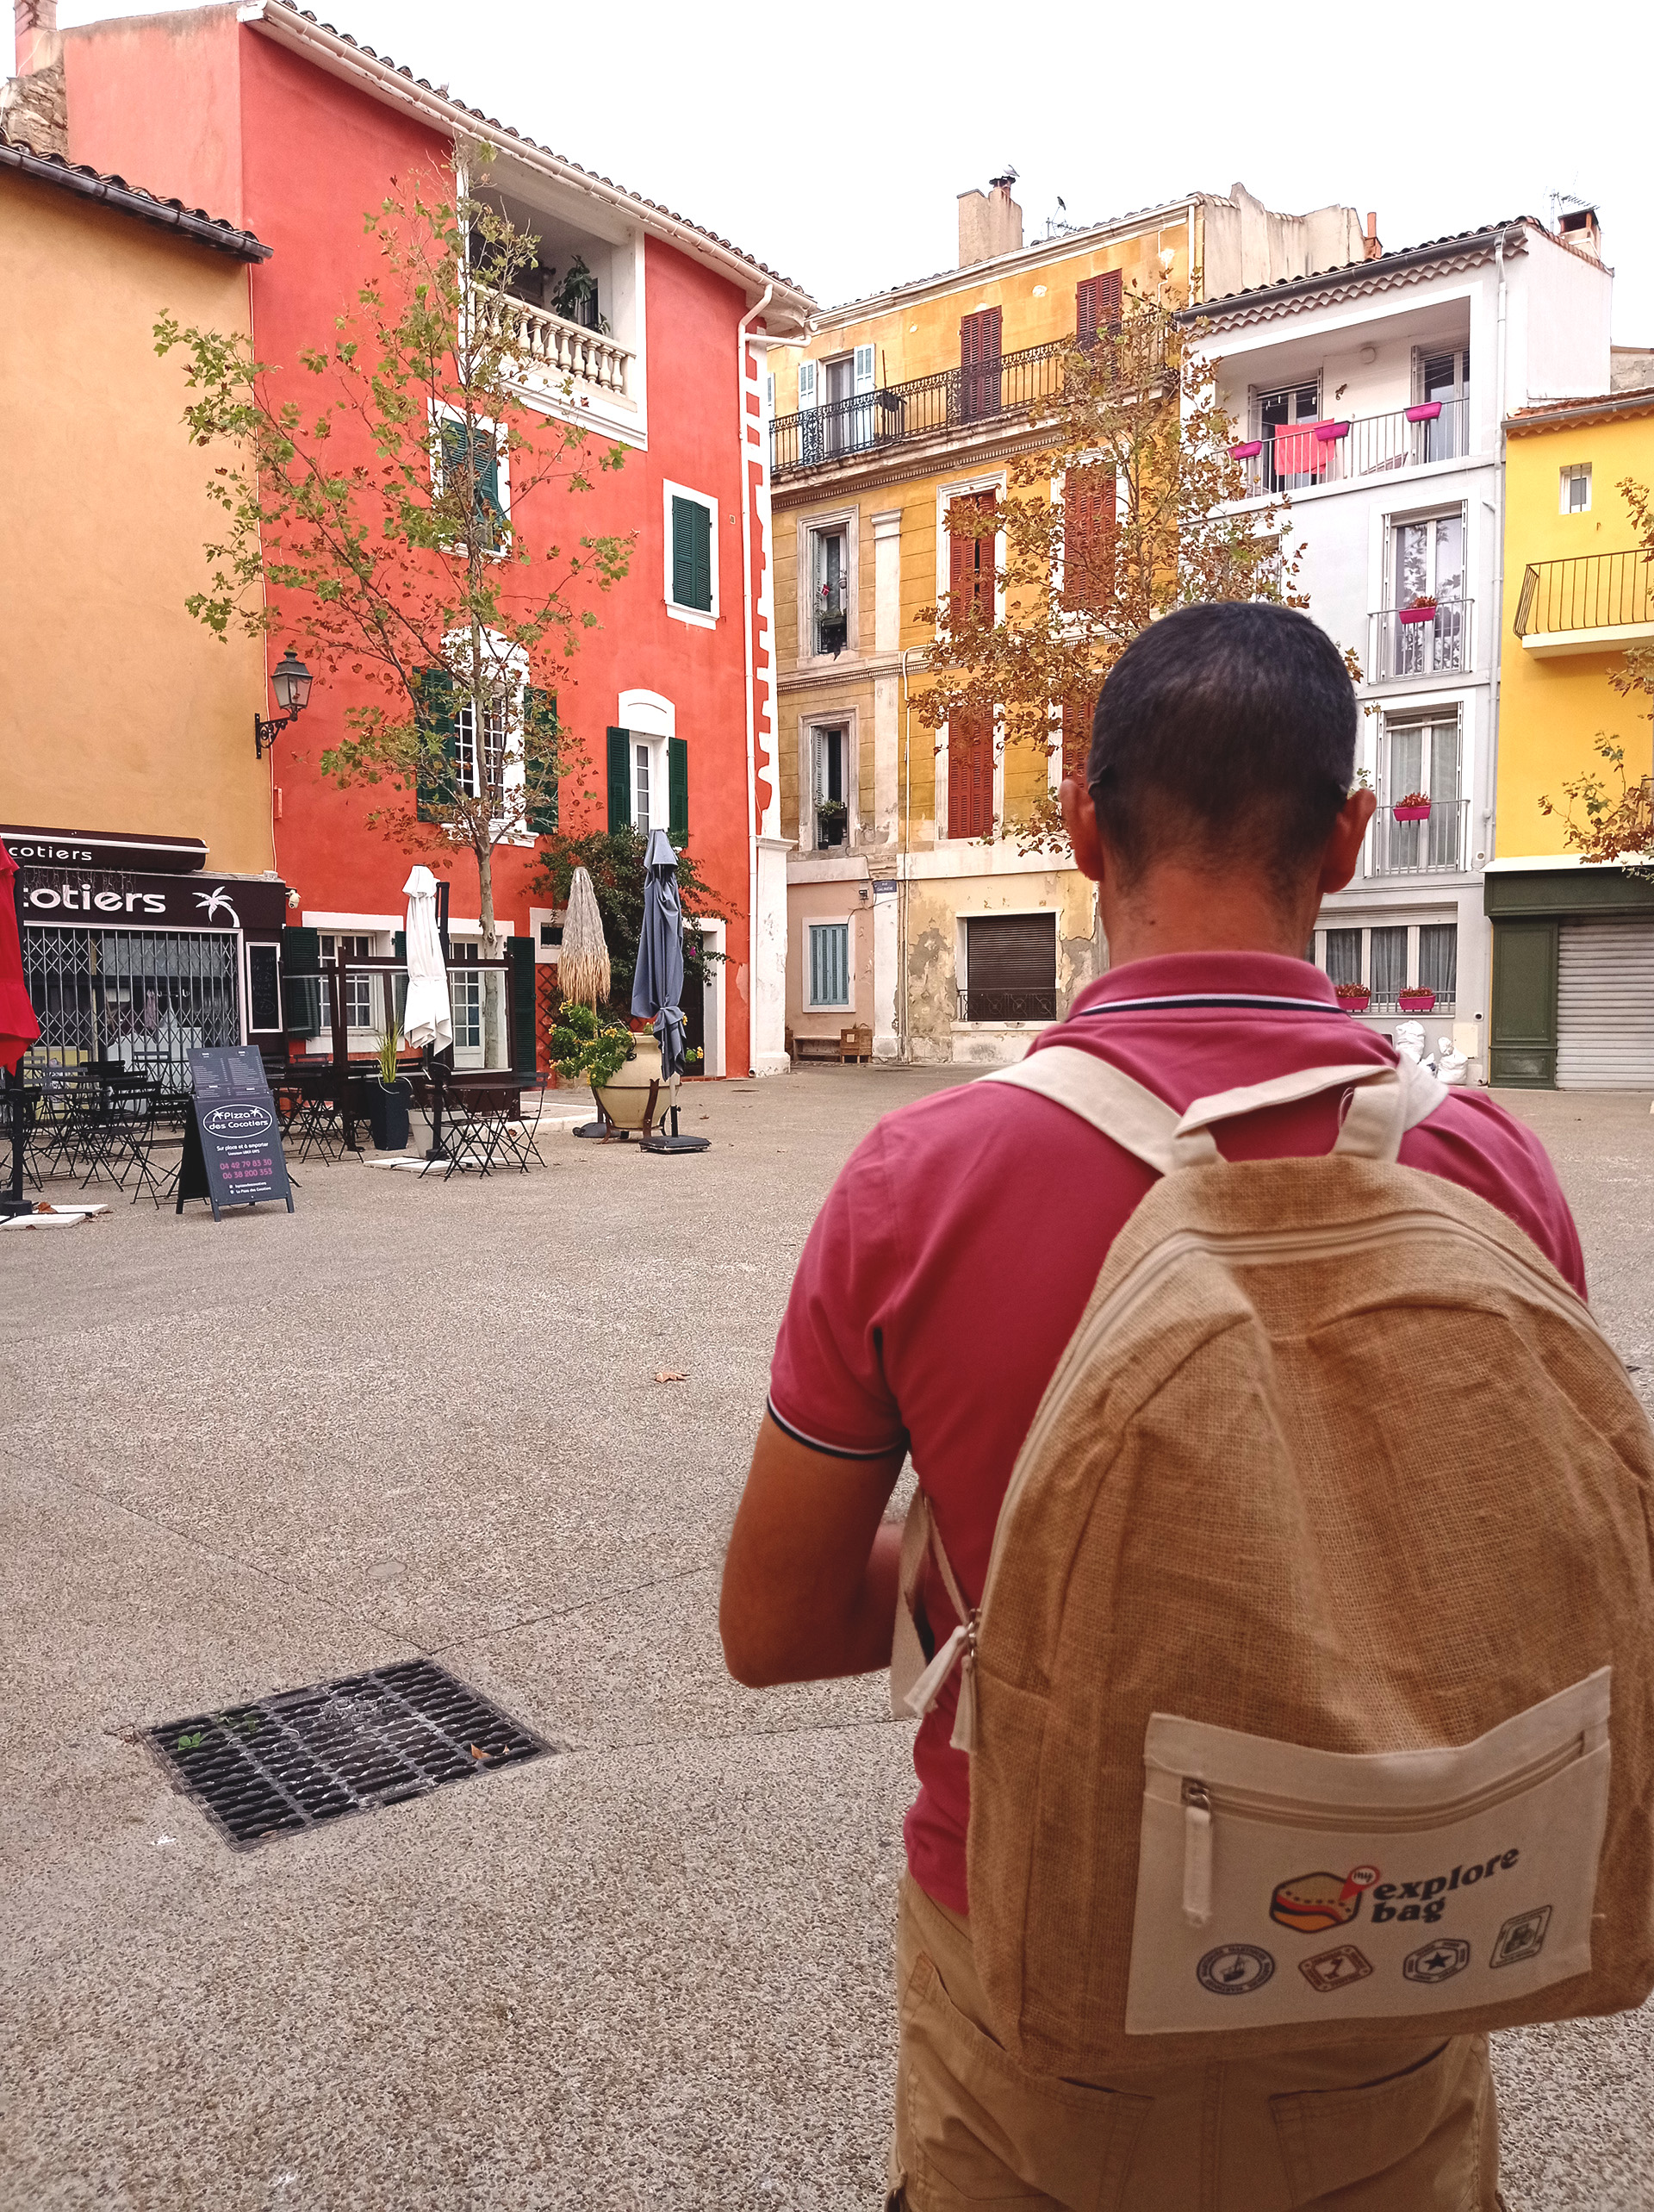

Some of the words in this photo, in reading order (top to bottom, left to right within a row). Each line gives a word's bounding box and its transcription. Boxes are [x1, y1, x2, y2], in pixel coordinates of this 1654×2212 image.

[23, 883, 166, 913] otiers
[1353, 1871, 1374, 1882] my
[1373, 1848, 1519, 1901] explore
[1371, 1897, 1446, 1923] bag
